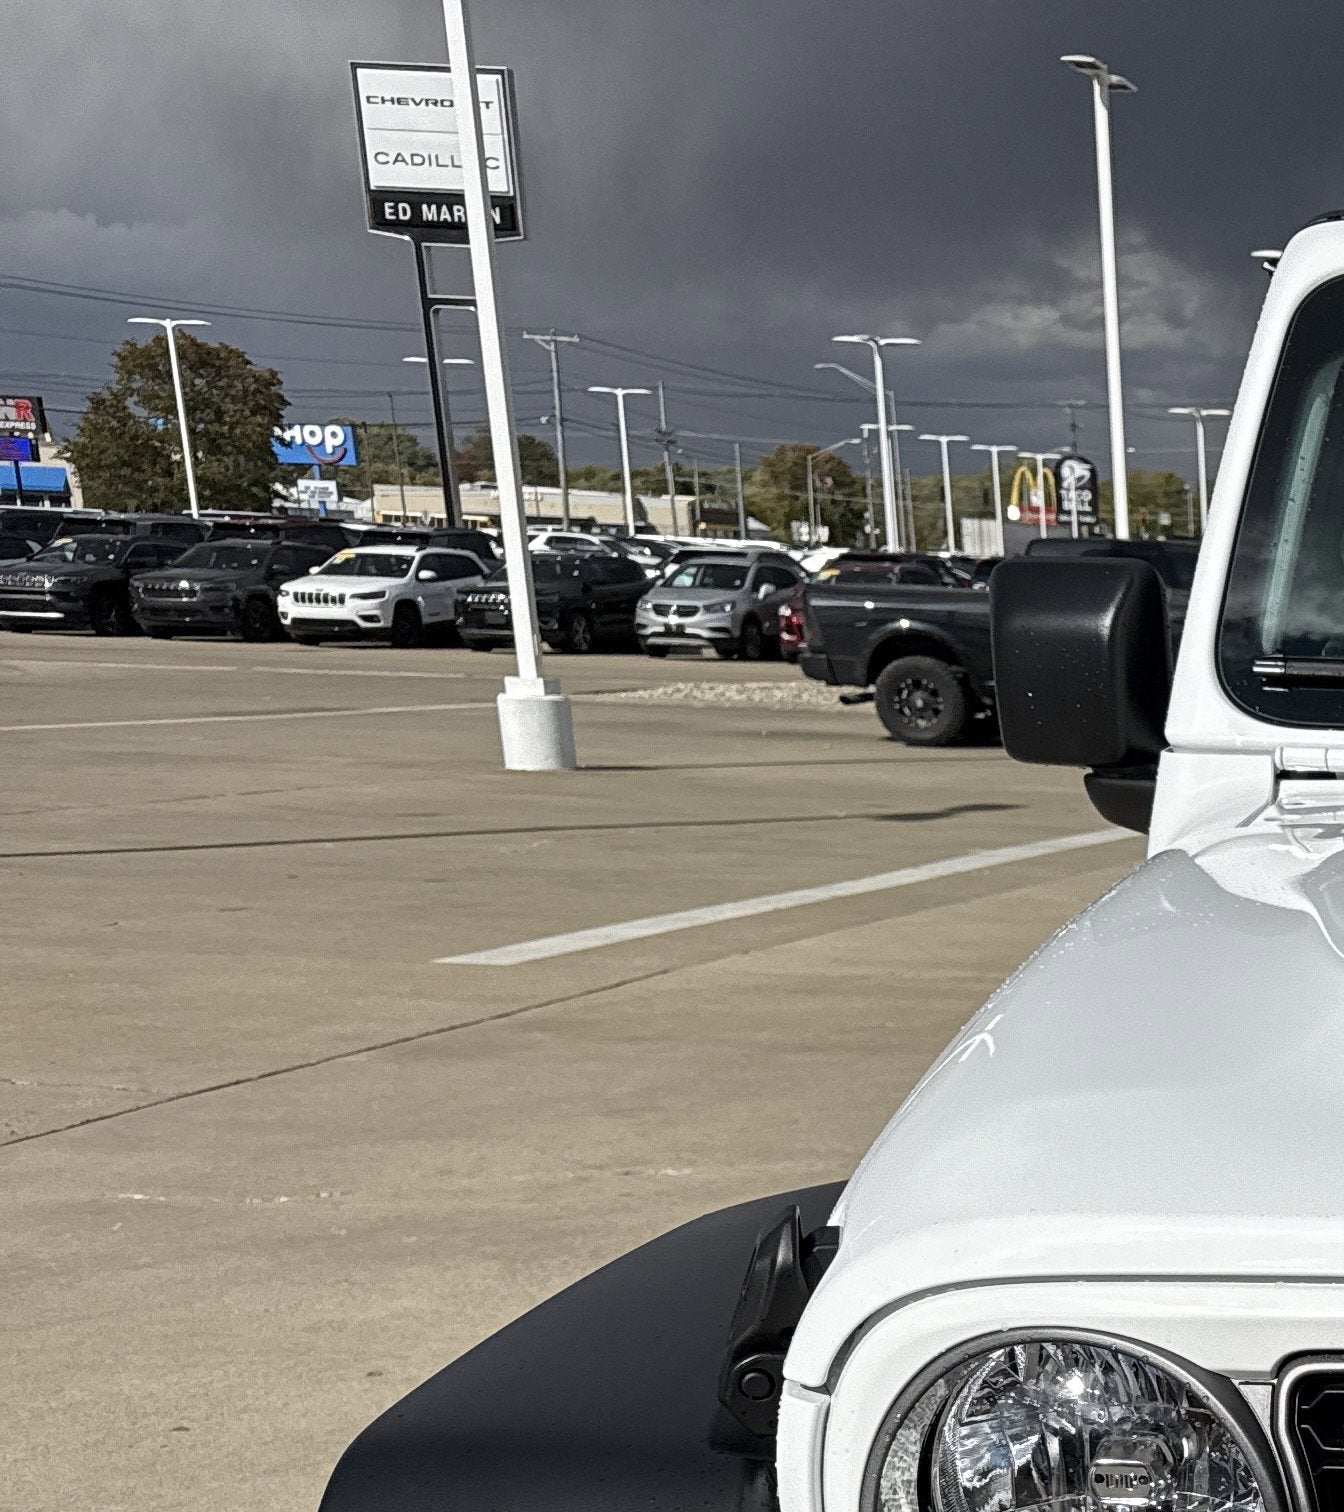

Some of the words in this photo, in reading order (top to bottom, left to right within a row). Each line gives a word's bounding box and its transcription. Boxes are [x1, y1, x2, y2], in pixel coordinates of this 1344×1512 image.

[366, 95, 494, 110] CHEVROT
[374, 151, 501, 170] CADILLC
[384, 202, 412, 220] ED
[422, 204, 501, 225] MARN
